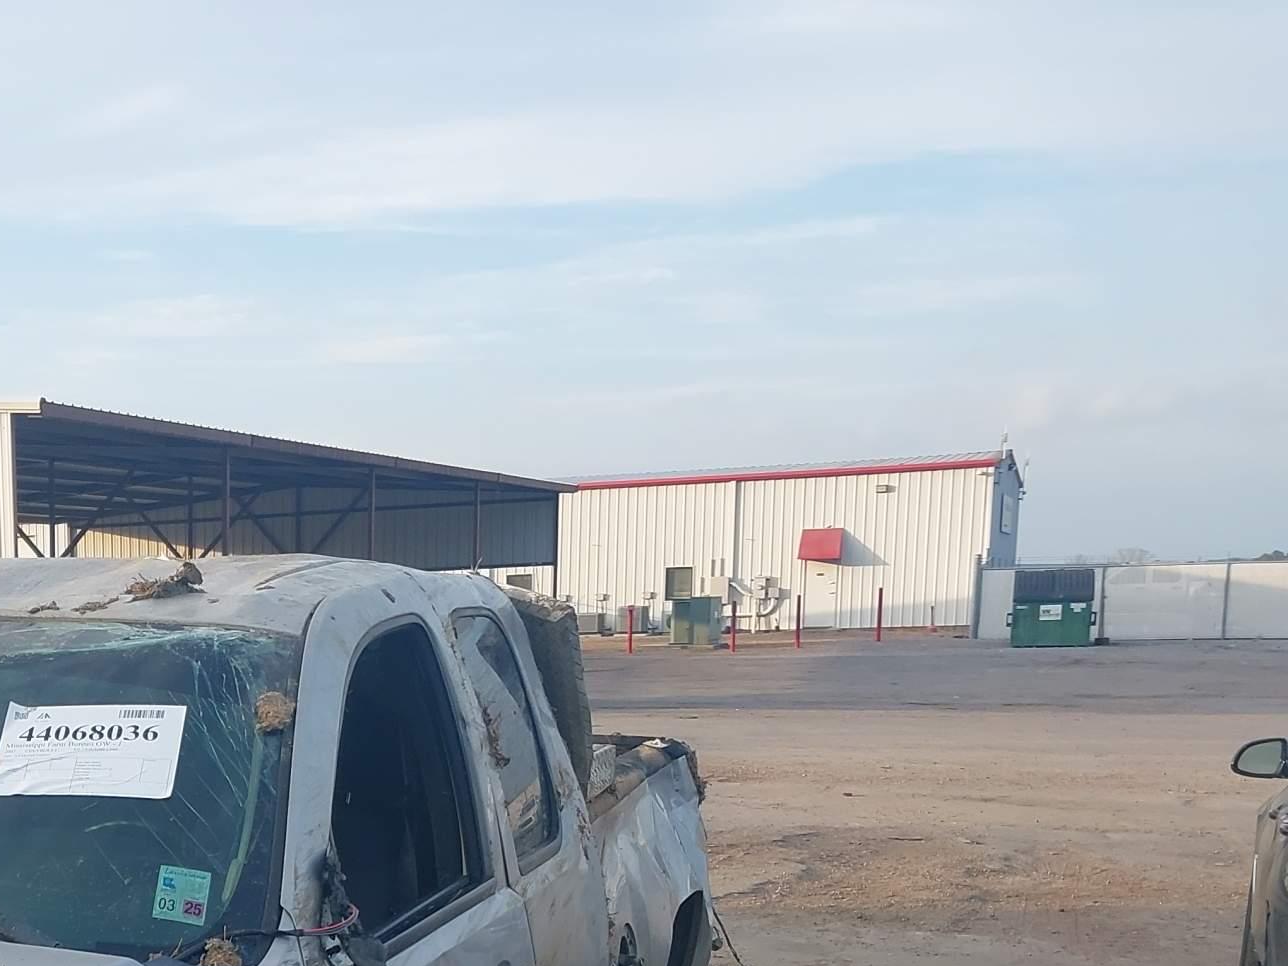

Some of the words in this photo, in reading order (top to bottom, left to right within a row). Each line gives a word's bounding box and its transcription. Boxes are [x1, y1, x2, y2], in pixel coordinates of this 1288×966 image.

[19, 724, 161, 742] 44068036
[158, 897, 176, 912] 03
[184, 901, 203, 917] 25
